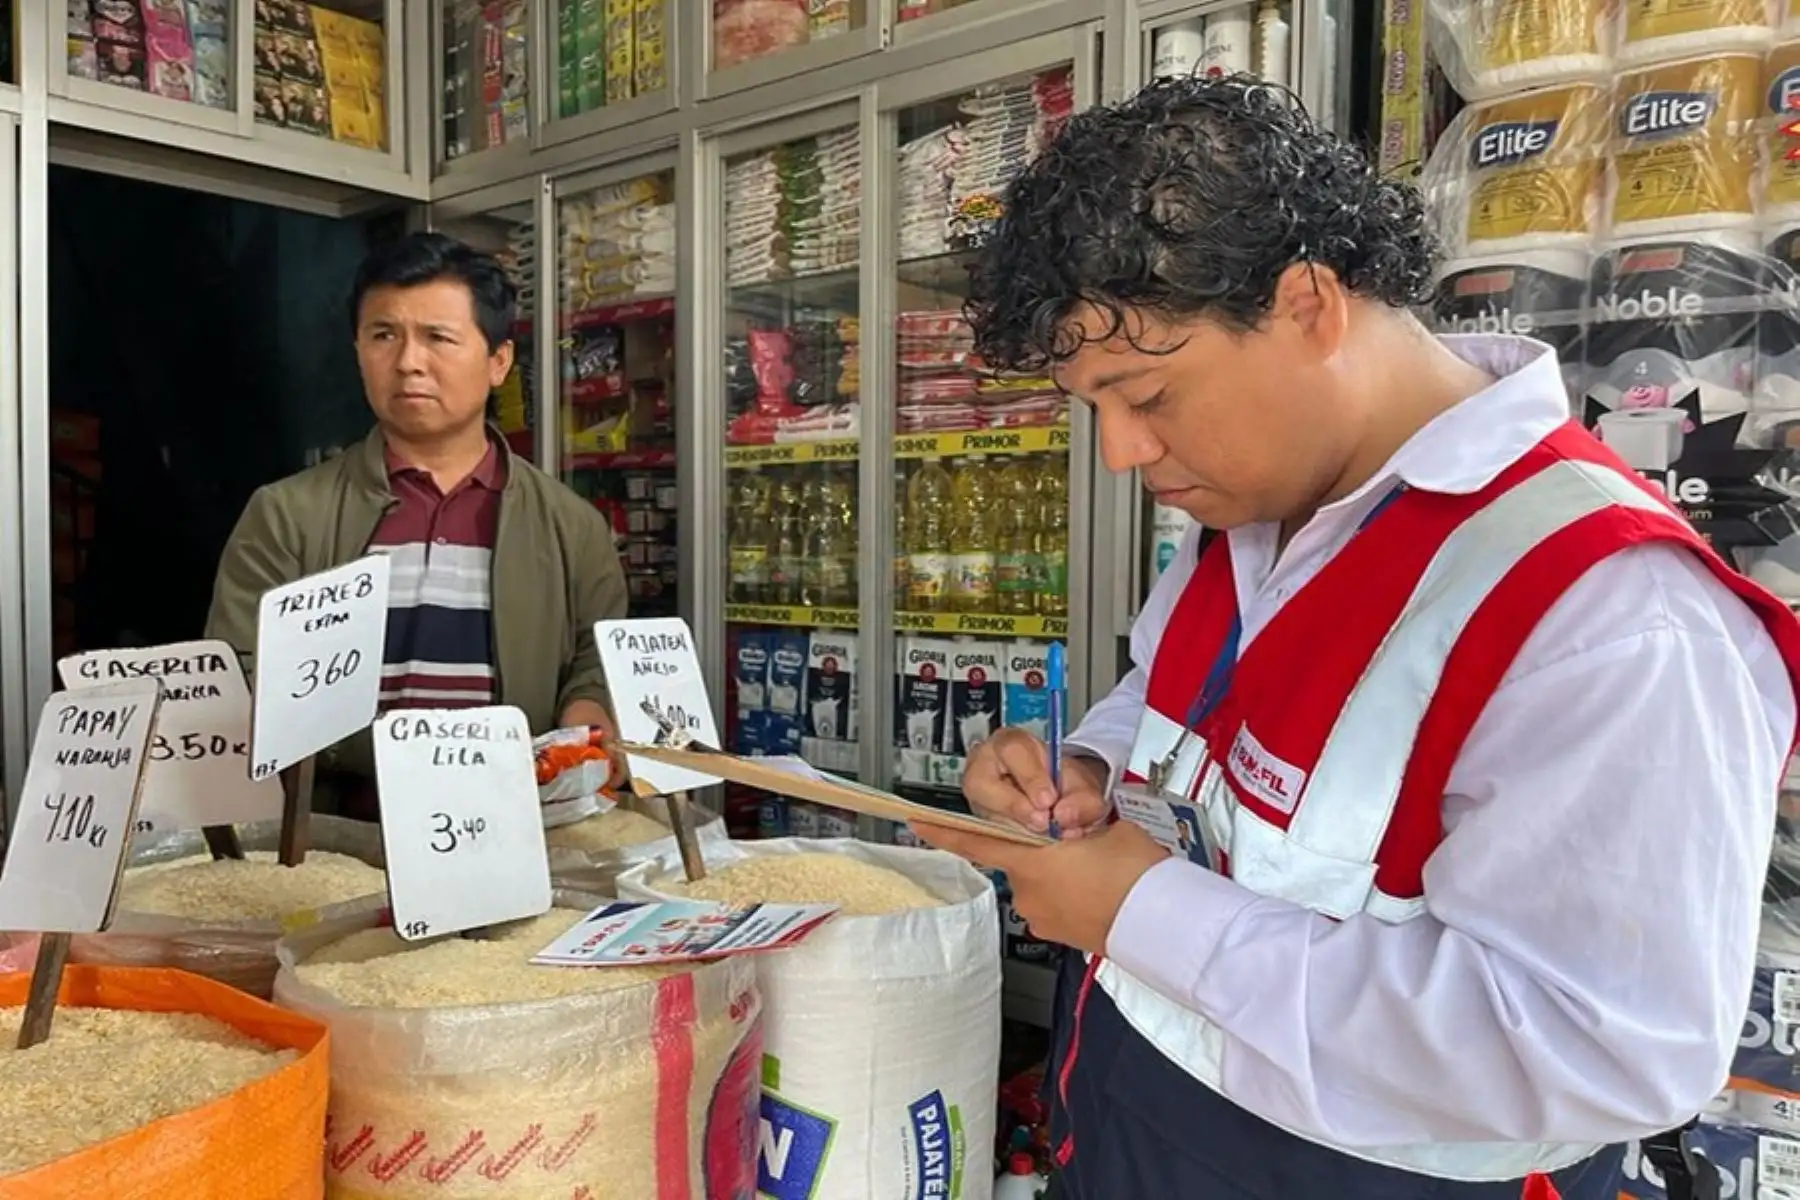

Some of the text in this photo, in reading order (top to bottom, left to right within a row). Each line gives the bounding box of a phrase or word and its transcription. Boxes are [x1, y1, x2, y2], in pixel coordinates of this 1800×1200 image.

[1627, 98, 1707, 134] Elite
[1479, 127, 1547, 163] Elite
[1596, 287, 1705, 323] Noble
[962, 435, 1021, 449] PRIMOR
[355, 572, 374, 599] B
[958, 615, 1015, 632] PRIMOR
[291, 649, 361, 699] 360
[908, 648, 1046, 672] GLORIA GLORIA GLOR
[161, 684, 221, 702] ARILLA
[58, 704, 138, 741] PAPAY
[389, 716, 521, 742] GASERIA
[917, 1102, 947, 1200] PAJATÉ
